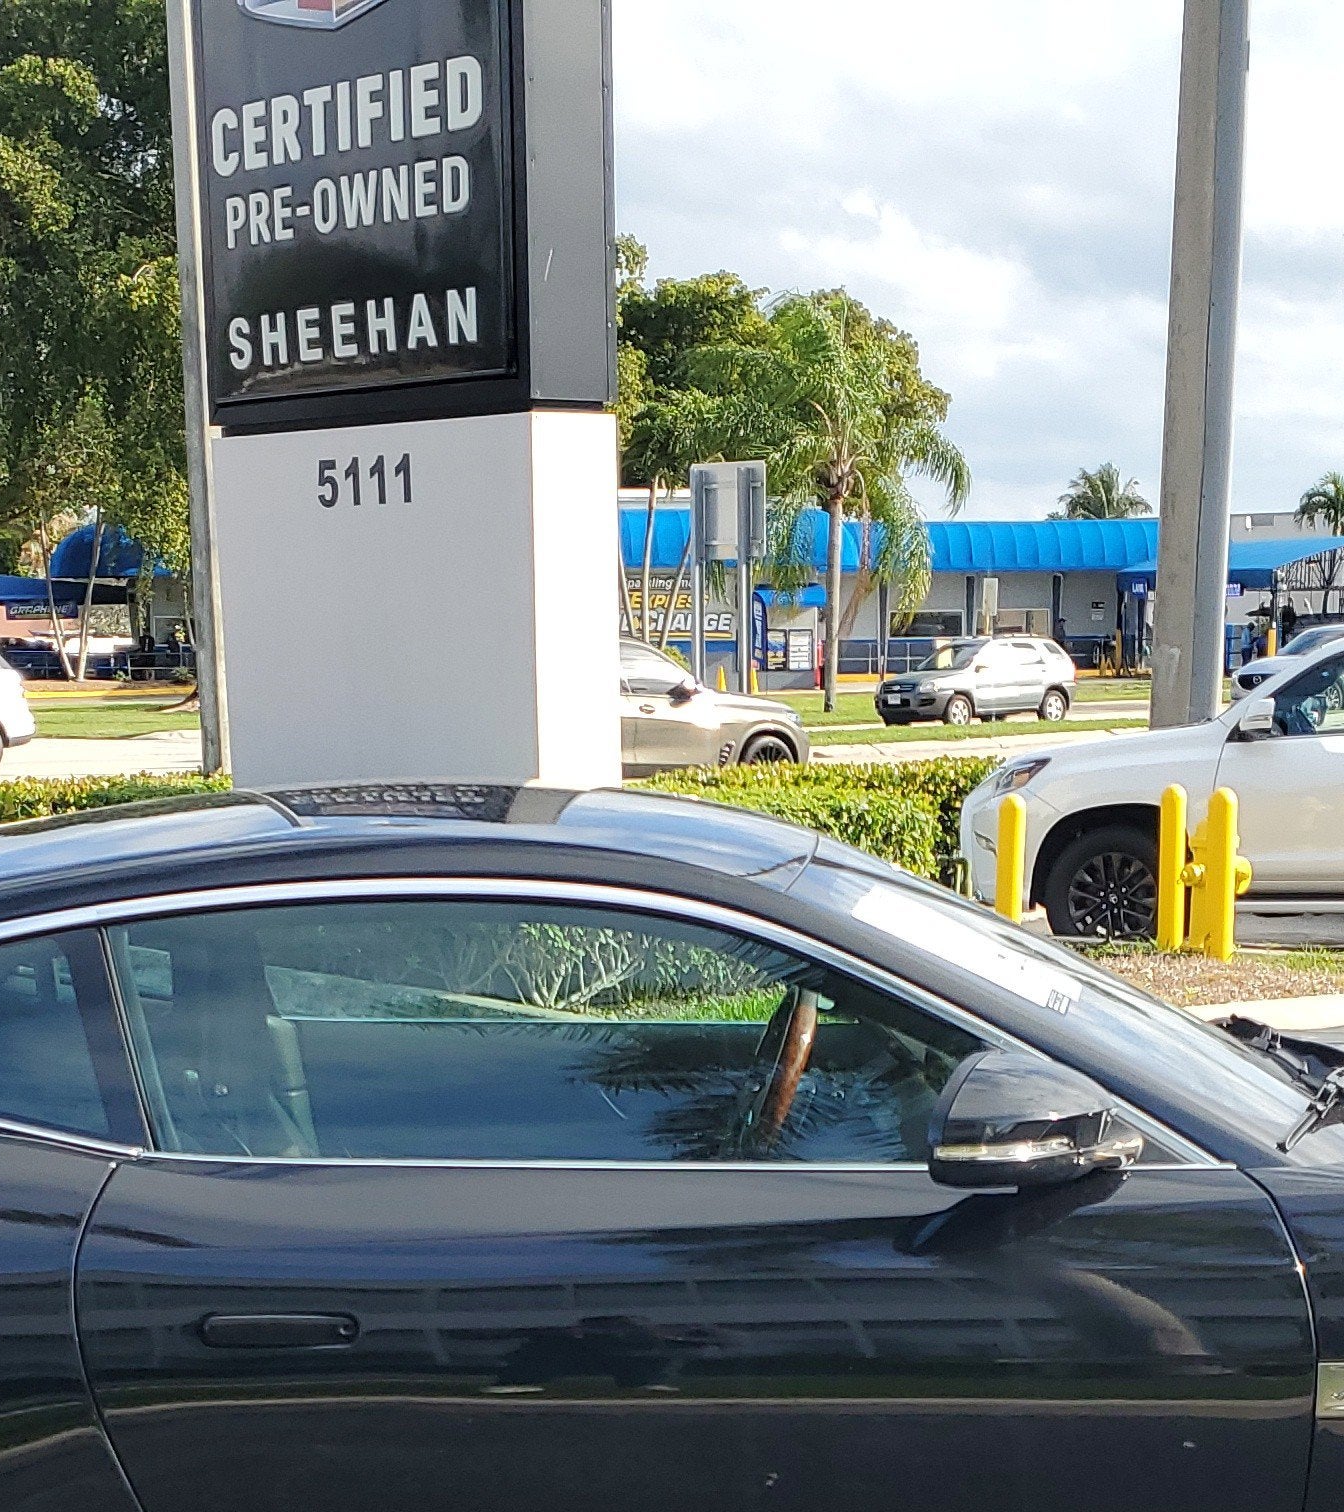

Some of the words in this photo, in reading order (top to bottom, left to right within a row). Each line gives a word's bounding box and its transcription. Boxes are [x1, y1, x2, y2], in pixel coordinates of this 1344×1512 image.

[211, 54, 484, 178] CERTIFIED
[226, 154, 471, 250] PRE-OWNED
[228, 286, 479, 371] SHEEHAN
[317, 453, 413, 509] 5111
